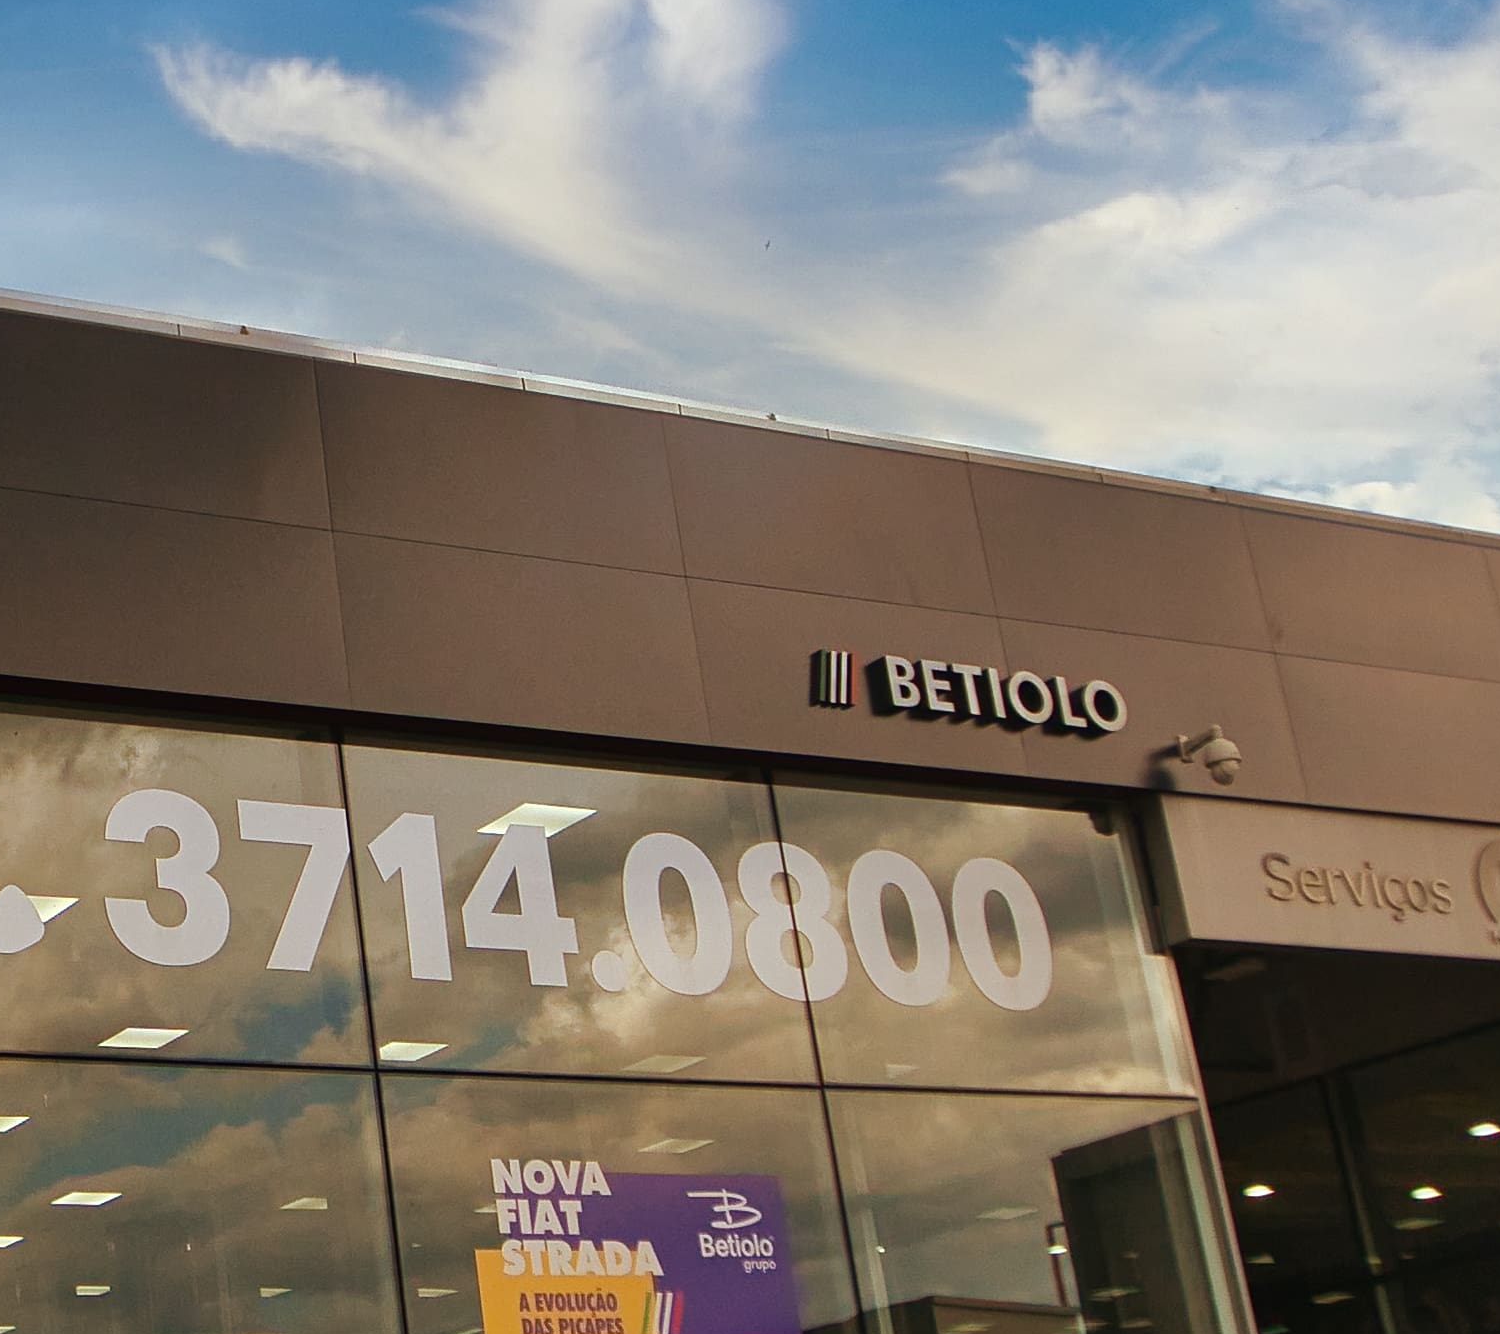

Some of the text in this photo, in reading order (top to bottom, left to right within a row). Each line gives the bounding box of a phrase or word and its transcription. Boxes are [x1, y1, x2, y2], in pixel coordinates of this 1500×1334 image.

[884, 654, 1128, 733] BETIOLO
[103, 788, 1054, 1012] 3714.0800
[1260, 851, 1453, 923] Serviços
[490, 1158, 612, 1197] NOVA
[496, 1198, 583, 1236] FIAT
[501, 1240, 664, 1276] STRADA
[699, 1233, 775, 1259] Betiolo
[744, 1259, 777, 1274] grupo
[519, 1287, 619, 1318] A EVOLUÇÃO
